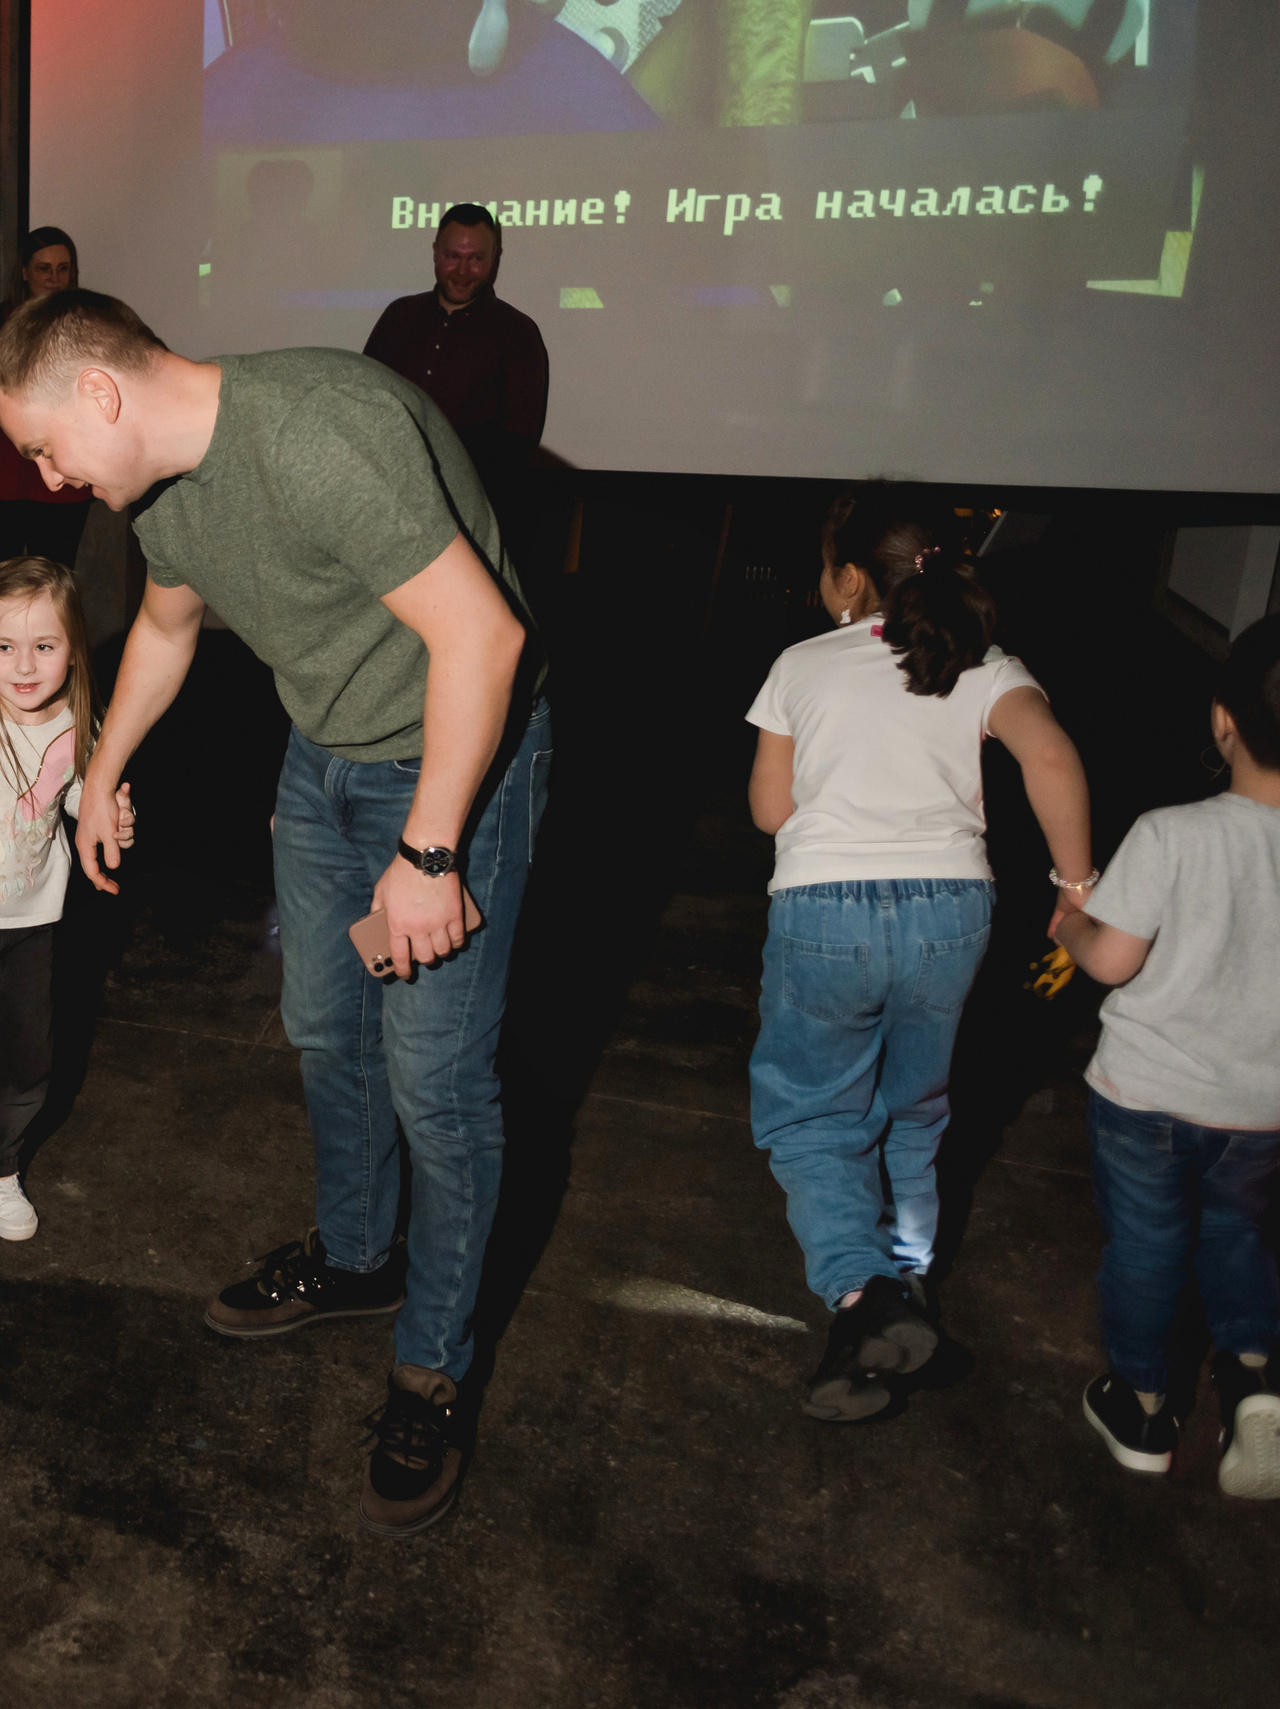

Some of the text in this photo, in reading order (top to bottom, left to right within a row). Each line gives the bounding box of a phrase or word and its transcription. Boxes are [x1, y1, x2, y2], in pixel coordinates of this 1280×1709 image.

[391, 174, 1103, 236] Внание! Игра началась!
